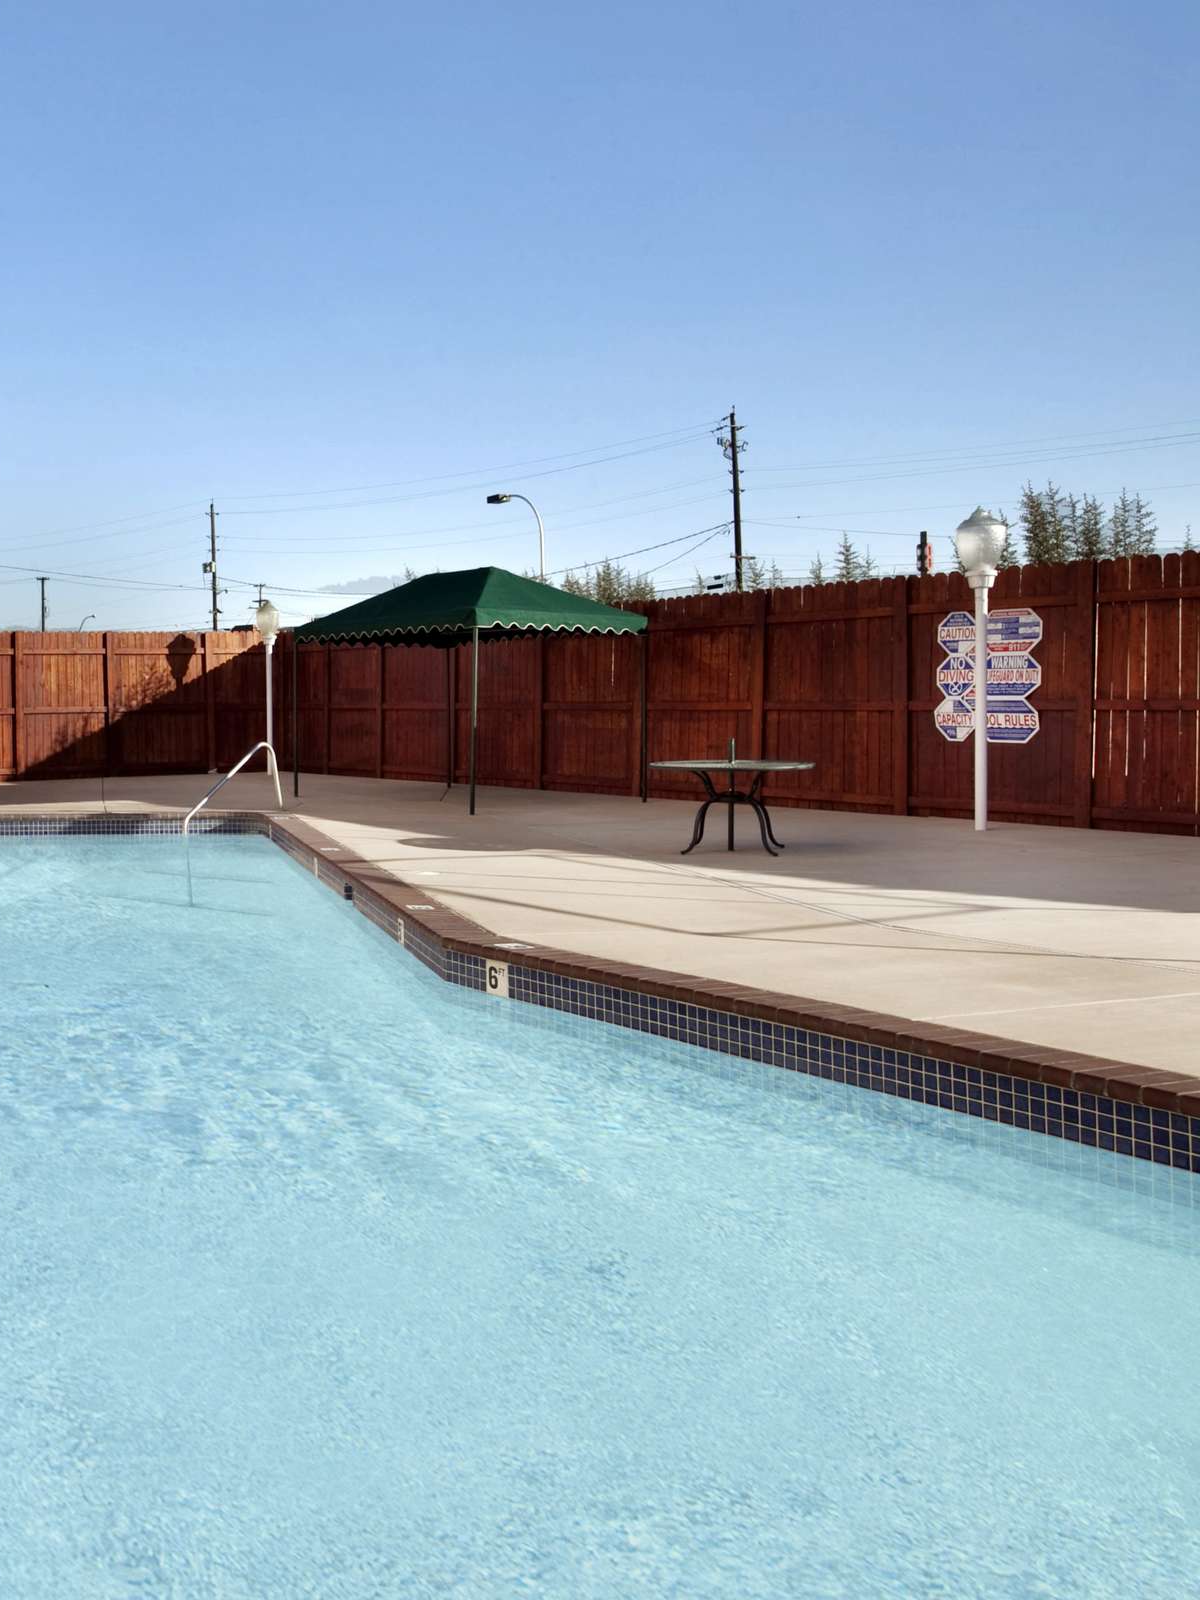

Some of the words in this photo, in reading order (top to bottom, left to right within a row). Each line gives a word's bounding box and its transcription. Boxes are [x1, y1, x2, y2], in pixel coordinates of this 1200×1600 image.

[940, 628, 976, 640] CAUTION
[950, 657, 965, 670] NO
[991, 655, 1029, 669] WARNING
[939, 670, 974, 682] DIVING
[936, 713, 972, 725] CAPACITY
[1004, 714, 1037, 727] RULES
[488, 966, 498, 989] 6
